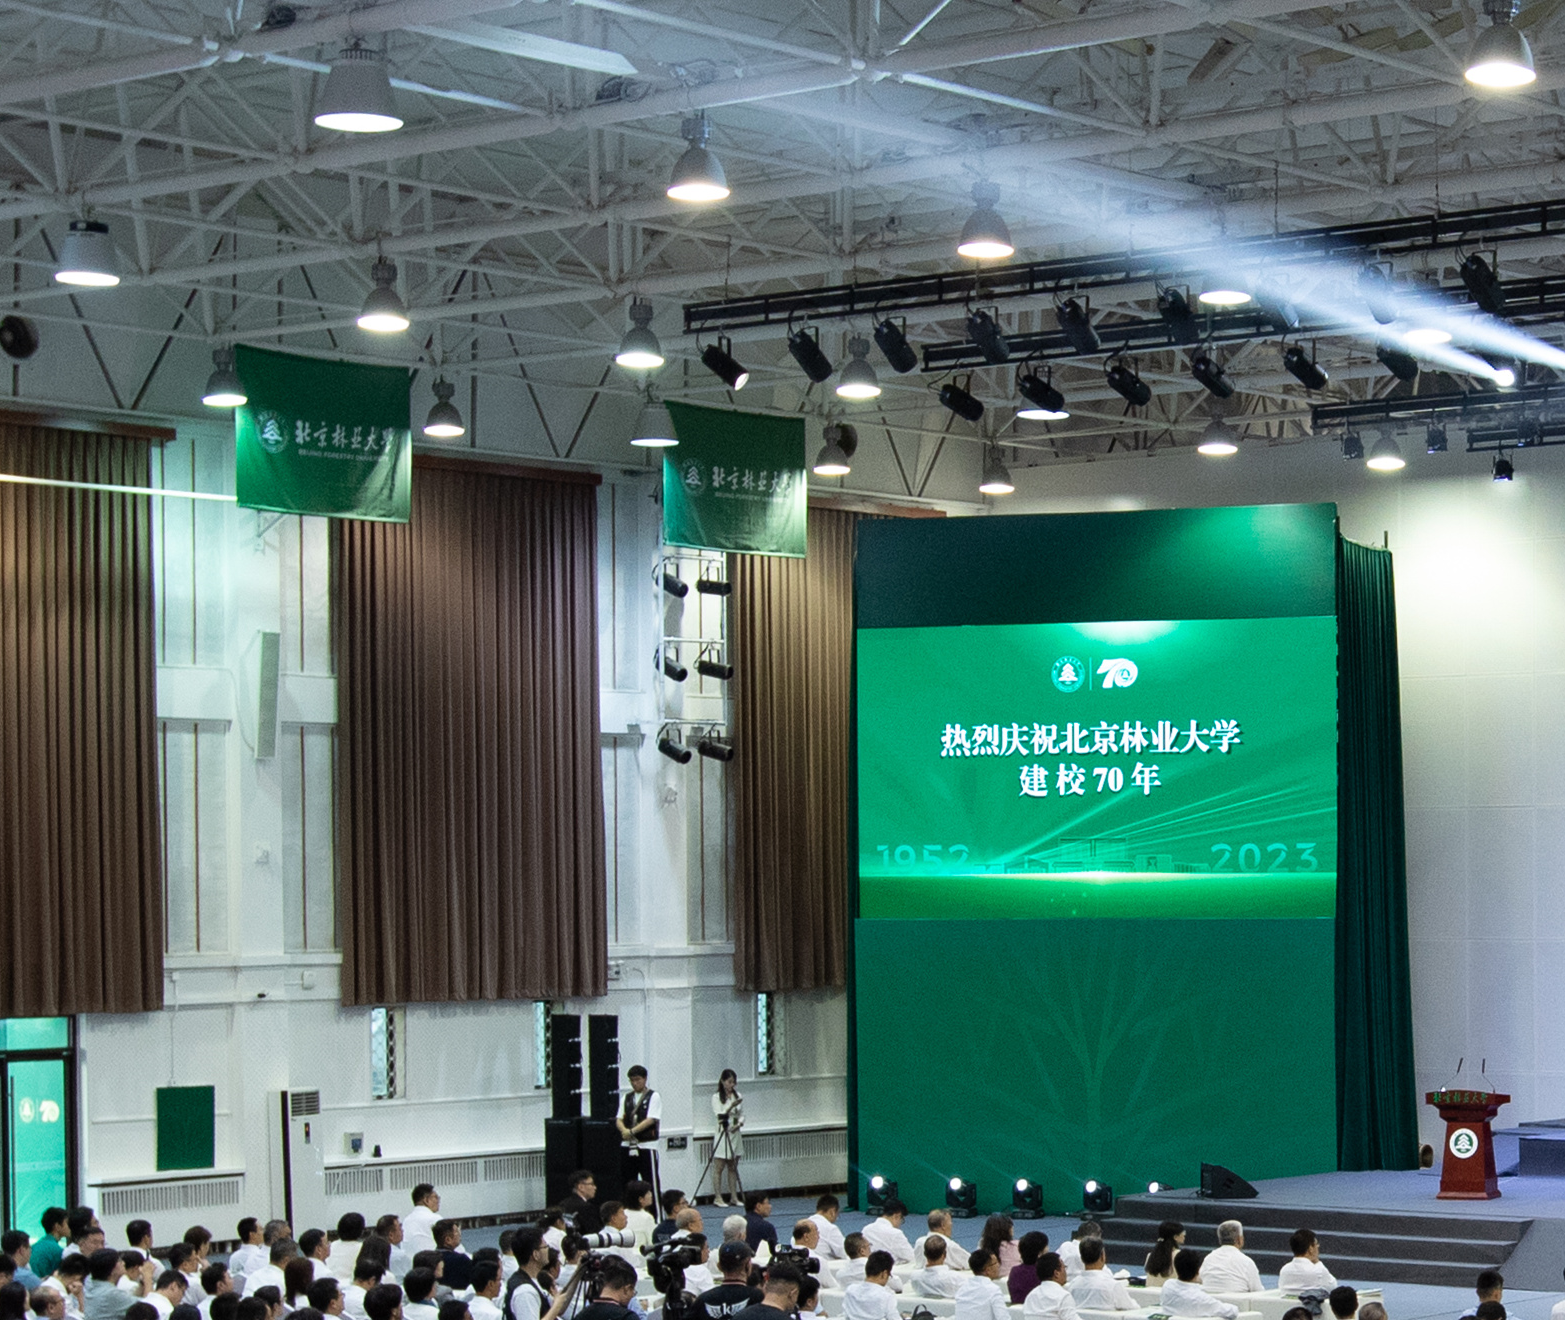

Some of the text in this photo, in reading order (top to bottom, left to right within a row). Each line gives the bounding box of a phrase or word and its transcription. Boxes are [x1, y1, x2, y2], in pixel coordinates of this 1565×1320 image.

[1096, 657, 1138, 688] 70
[940, 719, 1241, 758] 热烈庆祝北京林业大学
[877, 842, 1318, 872] 1952 2023
